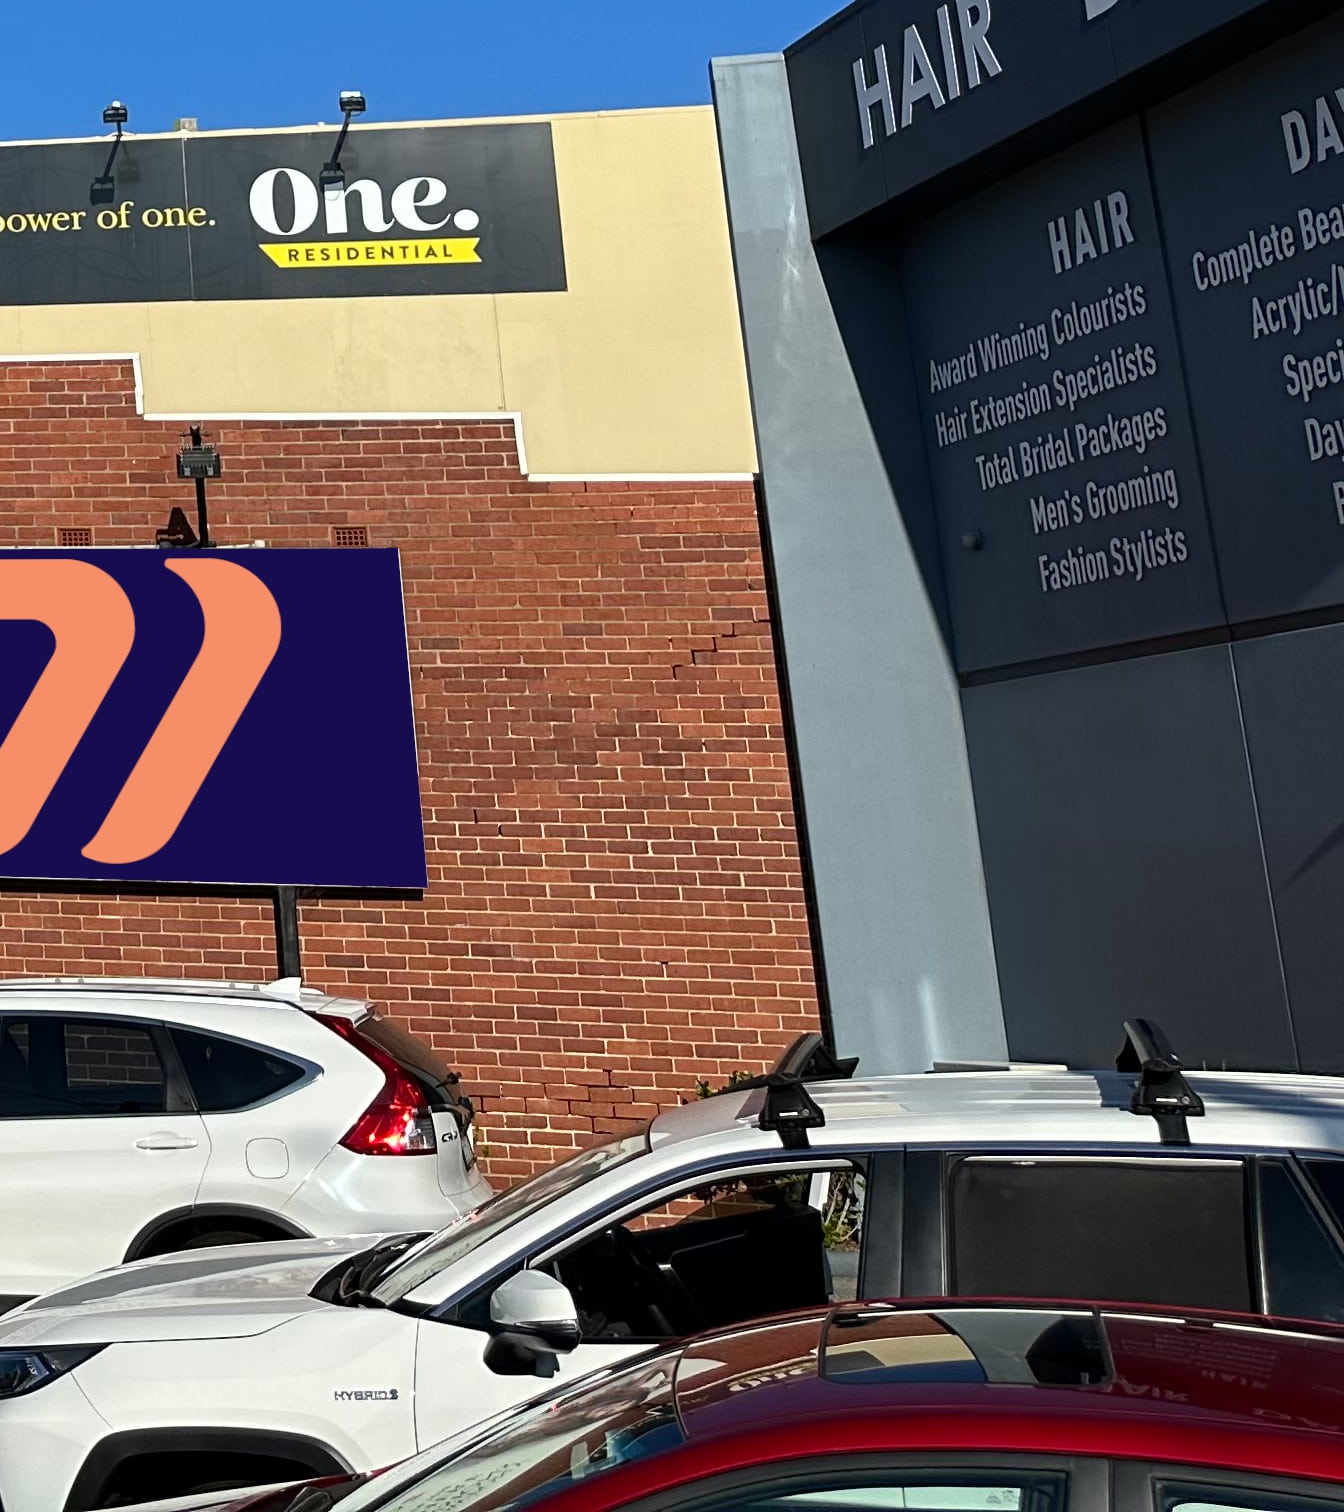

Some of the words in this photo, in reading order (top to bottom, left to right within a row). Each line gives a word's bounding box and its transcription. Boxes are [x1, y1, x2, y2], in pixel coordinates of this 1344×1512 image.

[1280, 87, 1344, 174] DA
[97, 201, 134, 231] of
[141, 203, 217, 229] one.
[249, 167, 480, 236] One.
[1047, 190, 1136, 274] HAIR
[288, 242, 455, 263] RESIDENTIAL
[1192, 224, 1295, 291] Complete
[1297, 203, 1344, 251] Bea
[929, 343, 978, 393] Award
[977, 322, 1050, 373] Winning
[1050, 282, 1147, 346] Colourists
[935, 406, 968, 448] Hair
[970, 381, 1052, 435] Extension
[1053, 343, 1157, 411] Specialists
[975, 446, 1019, 490] Total
[1019, 427, 1075, 478] Bridal
[1075, 406, 1168, 461] Packages
[1030, 489, 1084, 534] Men's
[1085, 465, 1179, 520] Grooming
[1038, 546, 1110, 592] Fashion
[1109, 527, 1188, 581] Stylists
[334, 1390, 389, 1401] HYBRID
